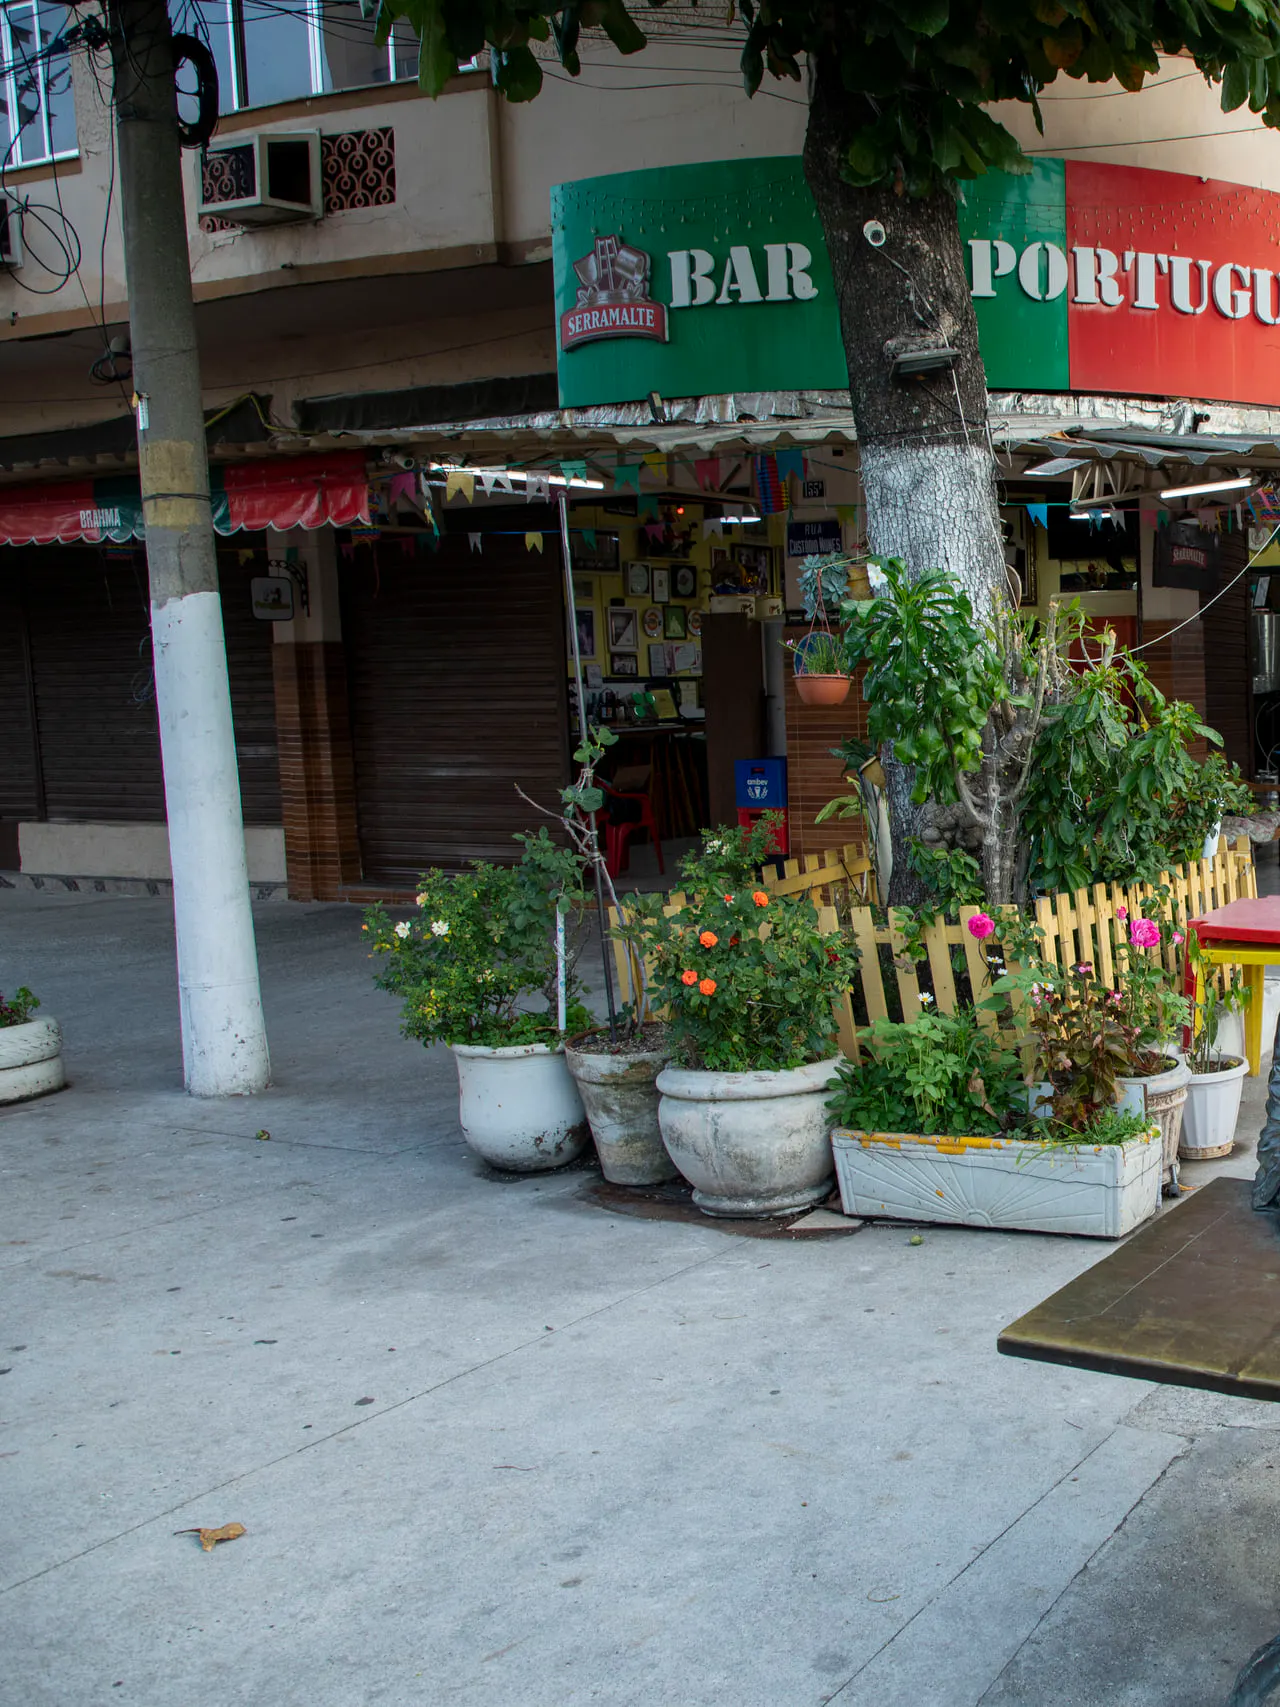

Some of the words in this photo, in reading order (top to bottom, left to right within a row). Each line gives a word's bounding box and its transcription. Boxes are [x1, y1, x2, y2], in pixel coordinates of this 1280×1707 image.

[667, 242, 819, 308] BAR
[567, 307, 655, 336] SERRAMALTE
[80, 508, 122, 529] BRAHMA
[804, 523, 822, 536] RUA
